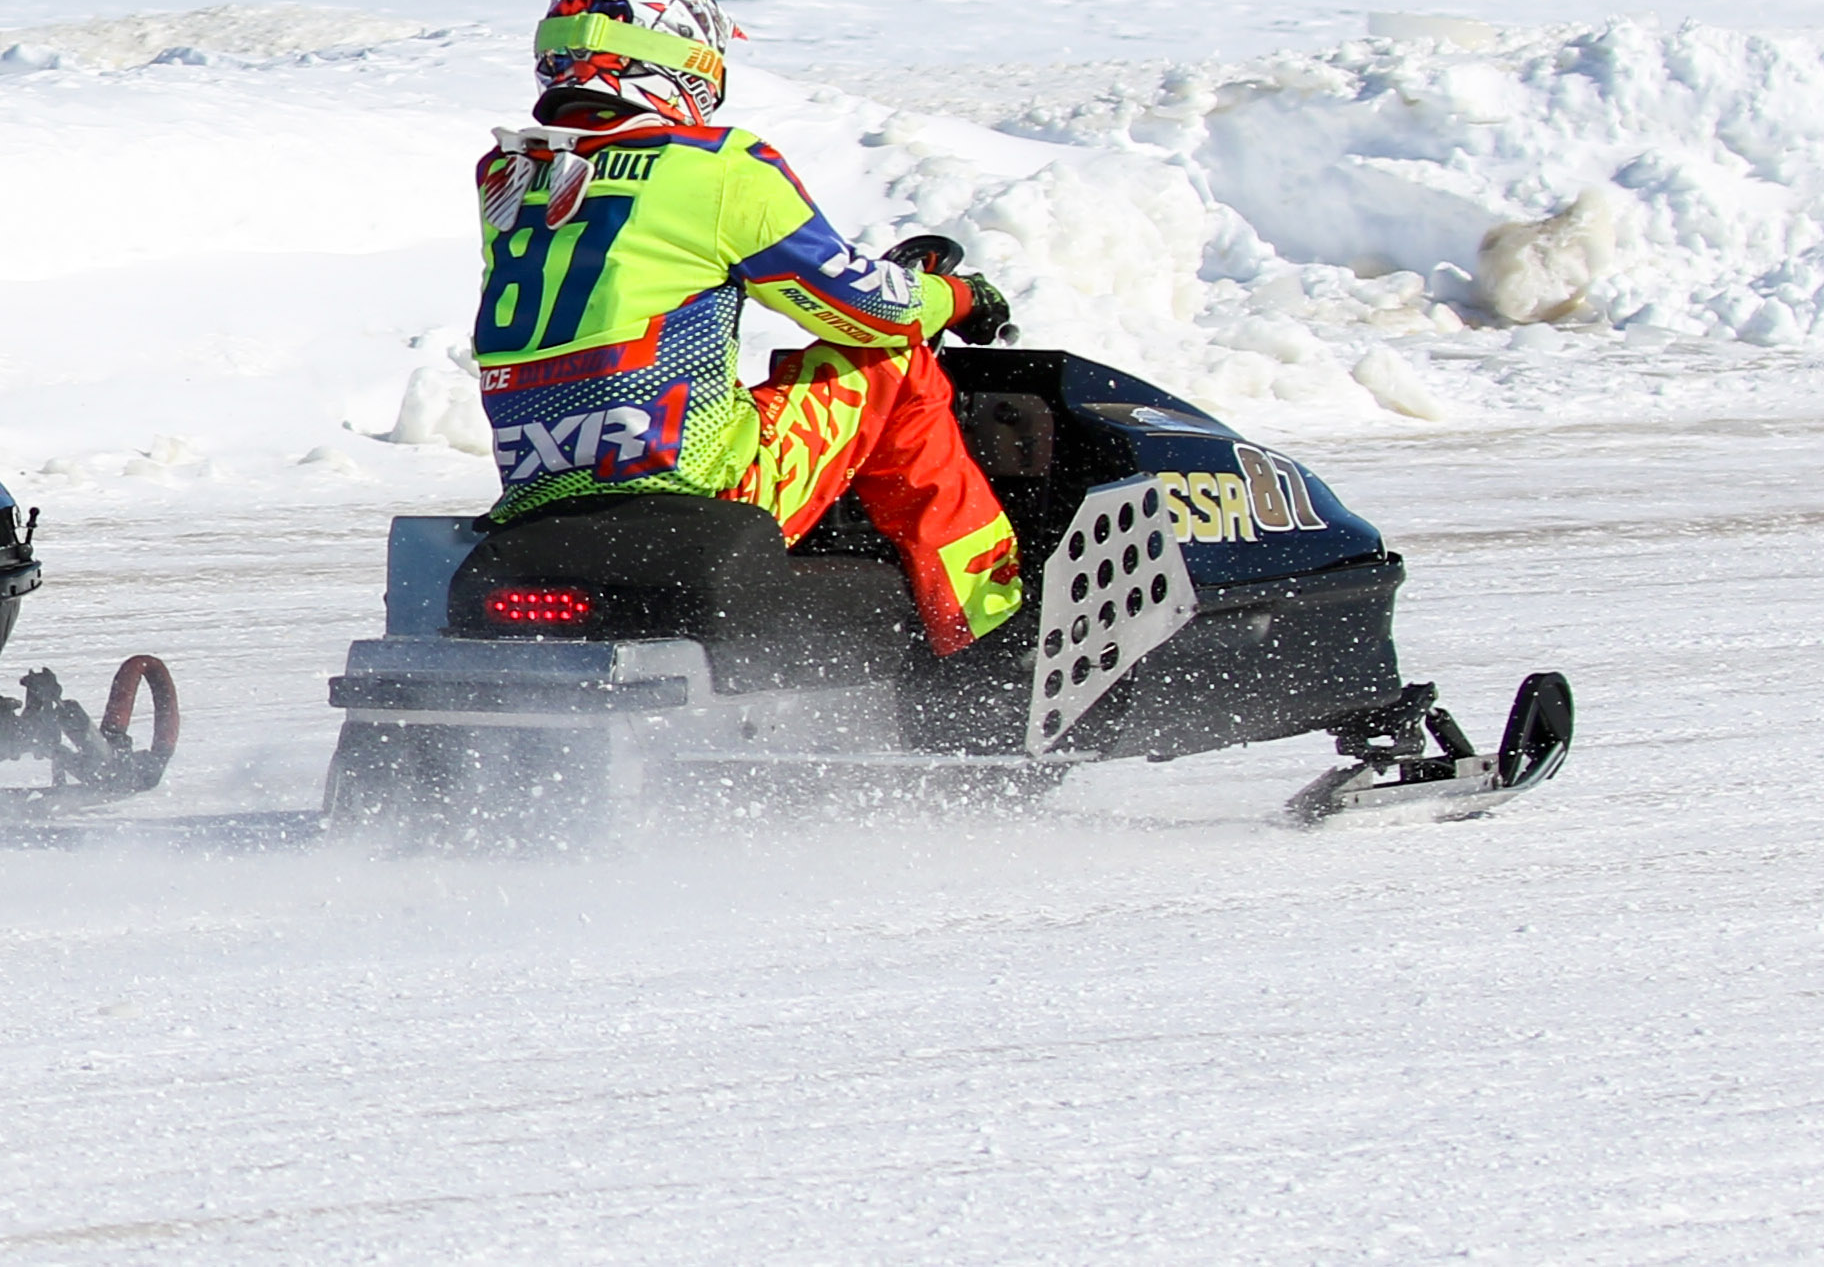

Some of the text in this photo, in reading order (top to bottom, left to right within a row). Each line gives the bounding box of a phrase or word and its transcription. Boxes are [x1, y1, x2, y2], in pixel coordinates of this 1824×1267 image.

[473, 194, 635, 356] 87
[779, 287, 879, 344] RACE DIVISION
[517, 346, 627, 385] DIVISION
[494, 405, 652, 480] FXR
[1156, 442, 1328, 543] SSR 87
